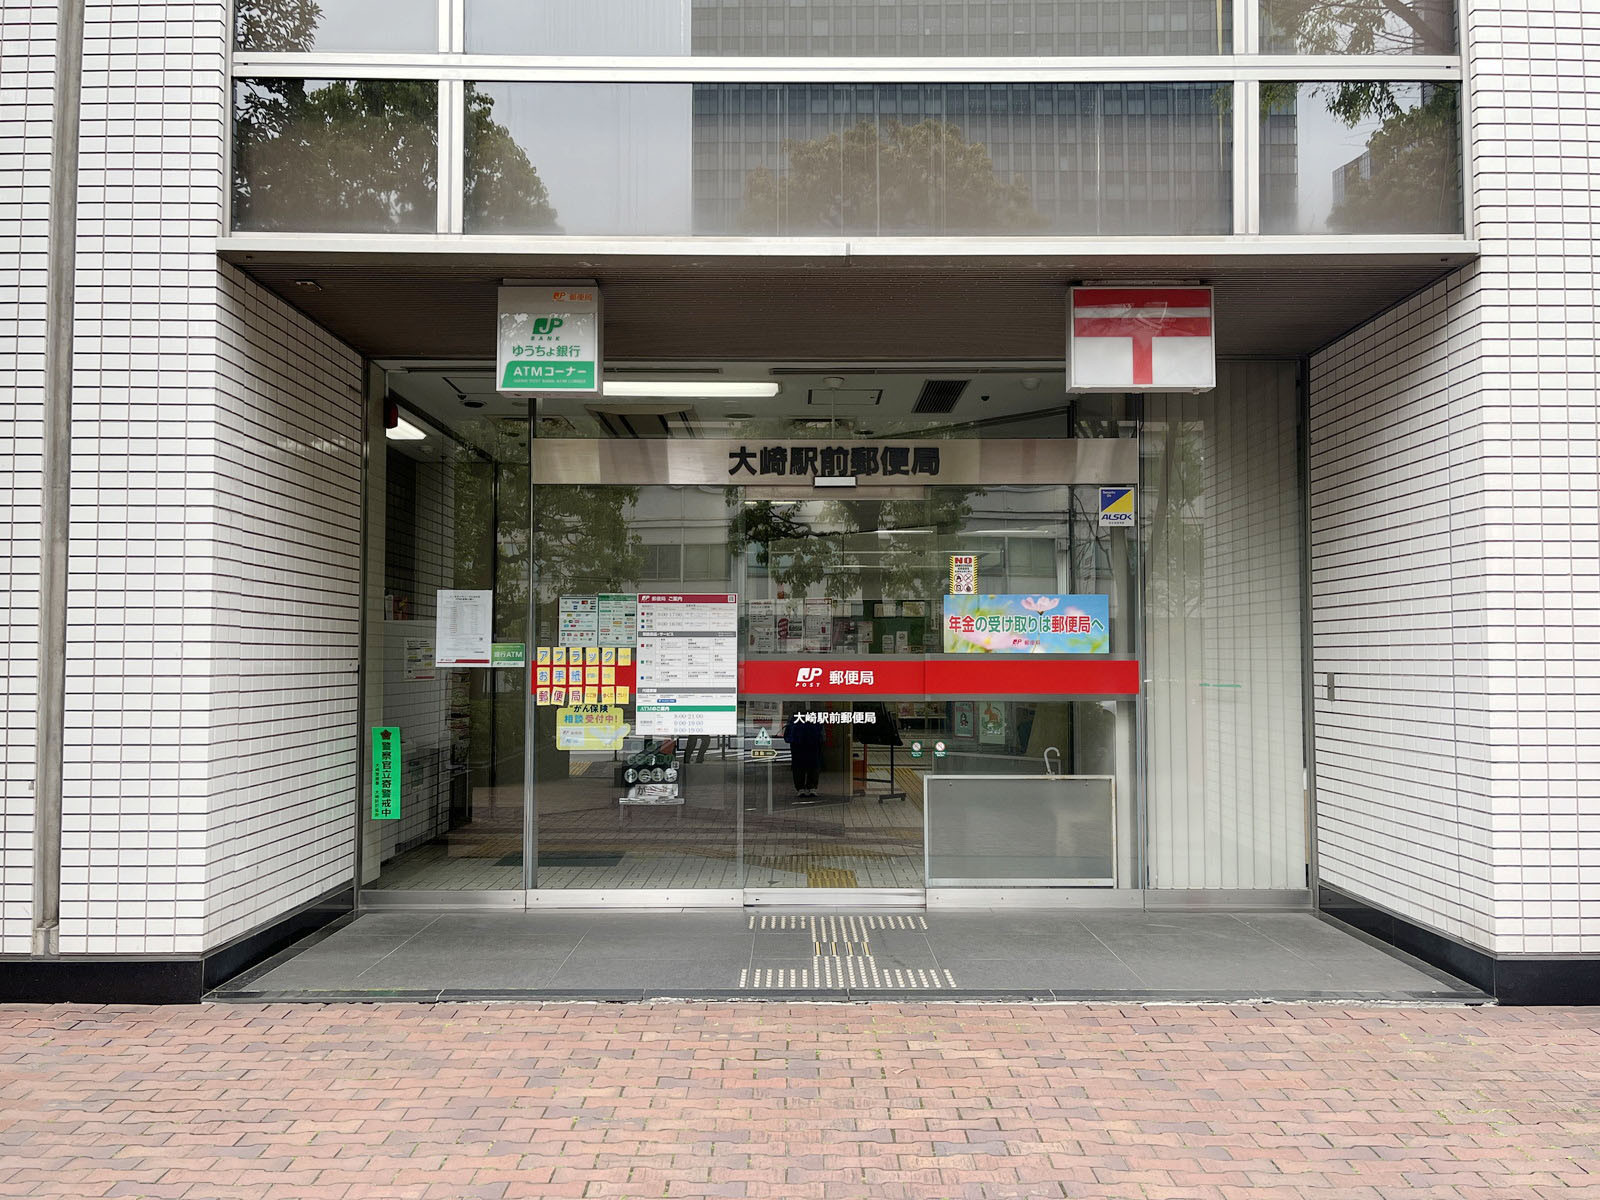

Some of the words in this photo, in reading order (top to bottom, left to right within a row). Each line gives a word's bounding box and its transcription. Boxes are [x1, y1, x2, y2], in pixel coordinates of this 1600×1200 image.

[532, 318, 564, 335] JP
[512, 345, 581, 358] ゆうちょ銀行
[513, 366, 587, 377] ATMコーナー
[728, 446, 940, 476] 大崎駅前郵便局
[1101, 513, 1133, 521] ALSOK
[948, 615, 1104, 634] 年金の受け取りは郵便局へ
[539, 650, 613, 662] アフラック
[539, 670, 581, 682] お手紙
[796, 667, 823, 682] JP
[829, 670, 874, 685] 郵便局
[793, 712, 877, 724] 大崎駅前郵便局
[381, 741, 392, 817] 警察官立寄警戒中
